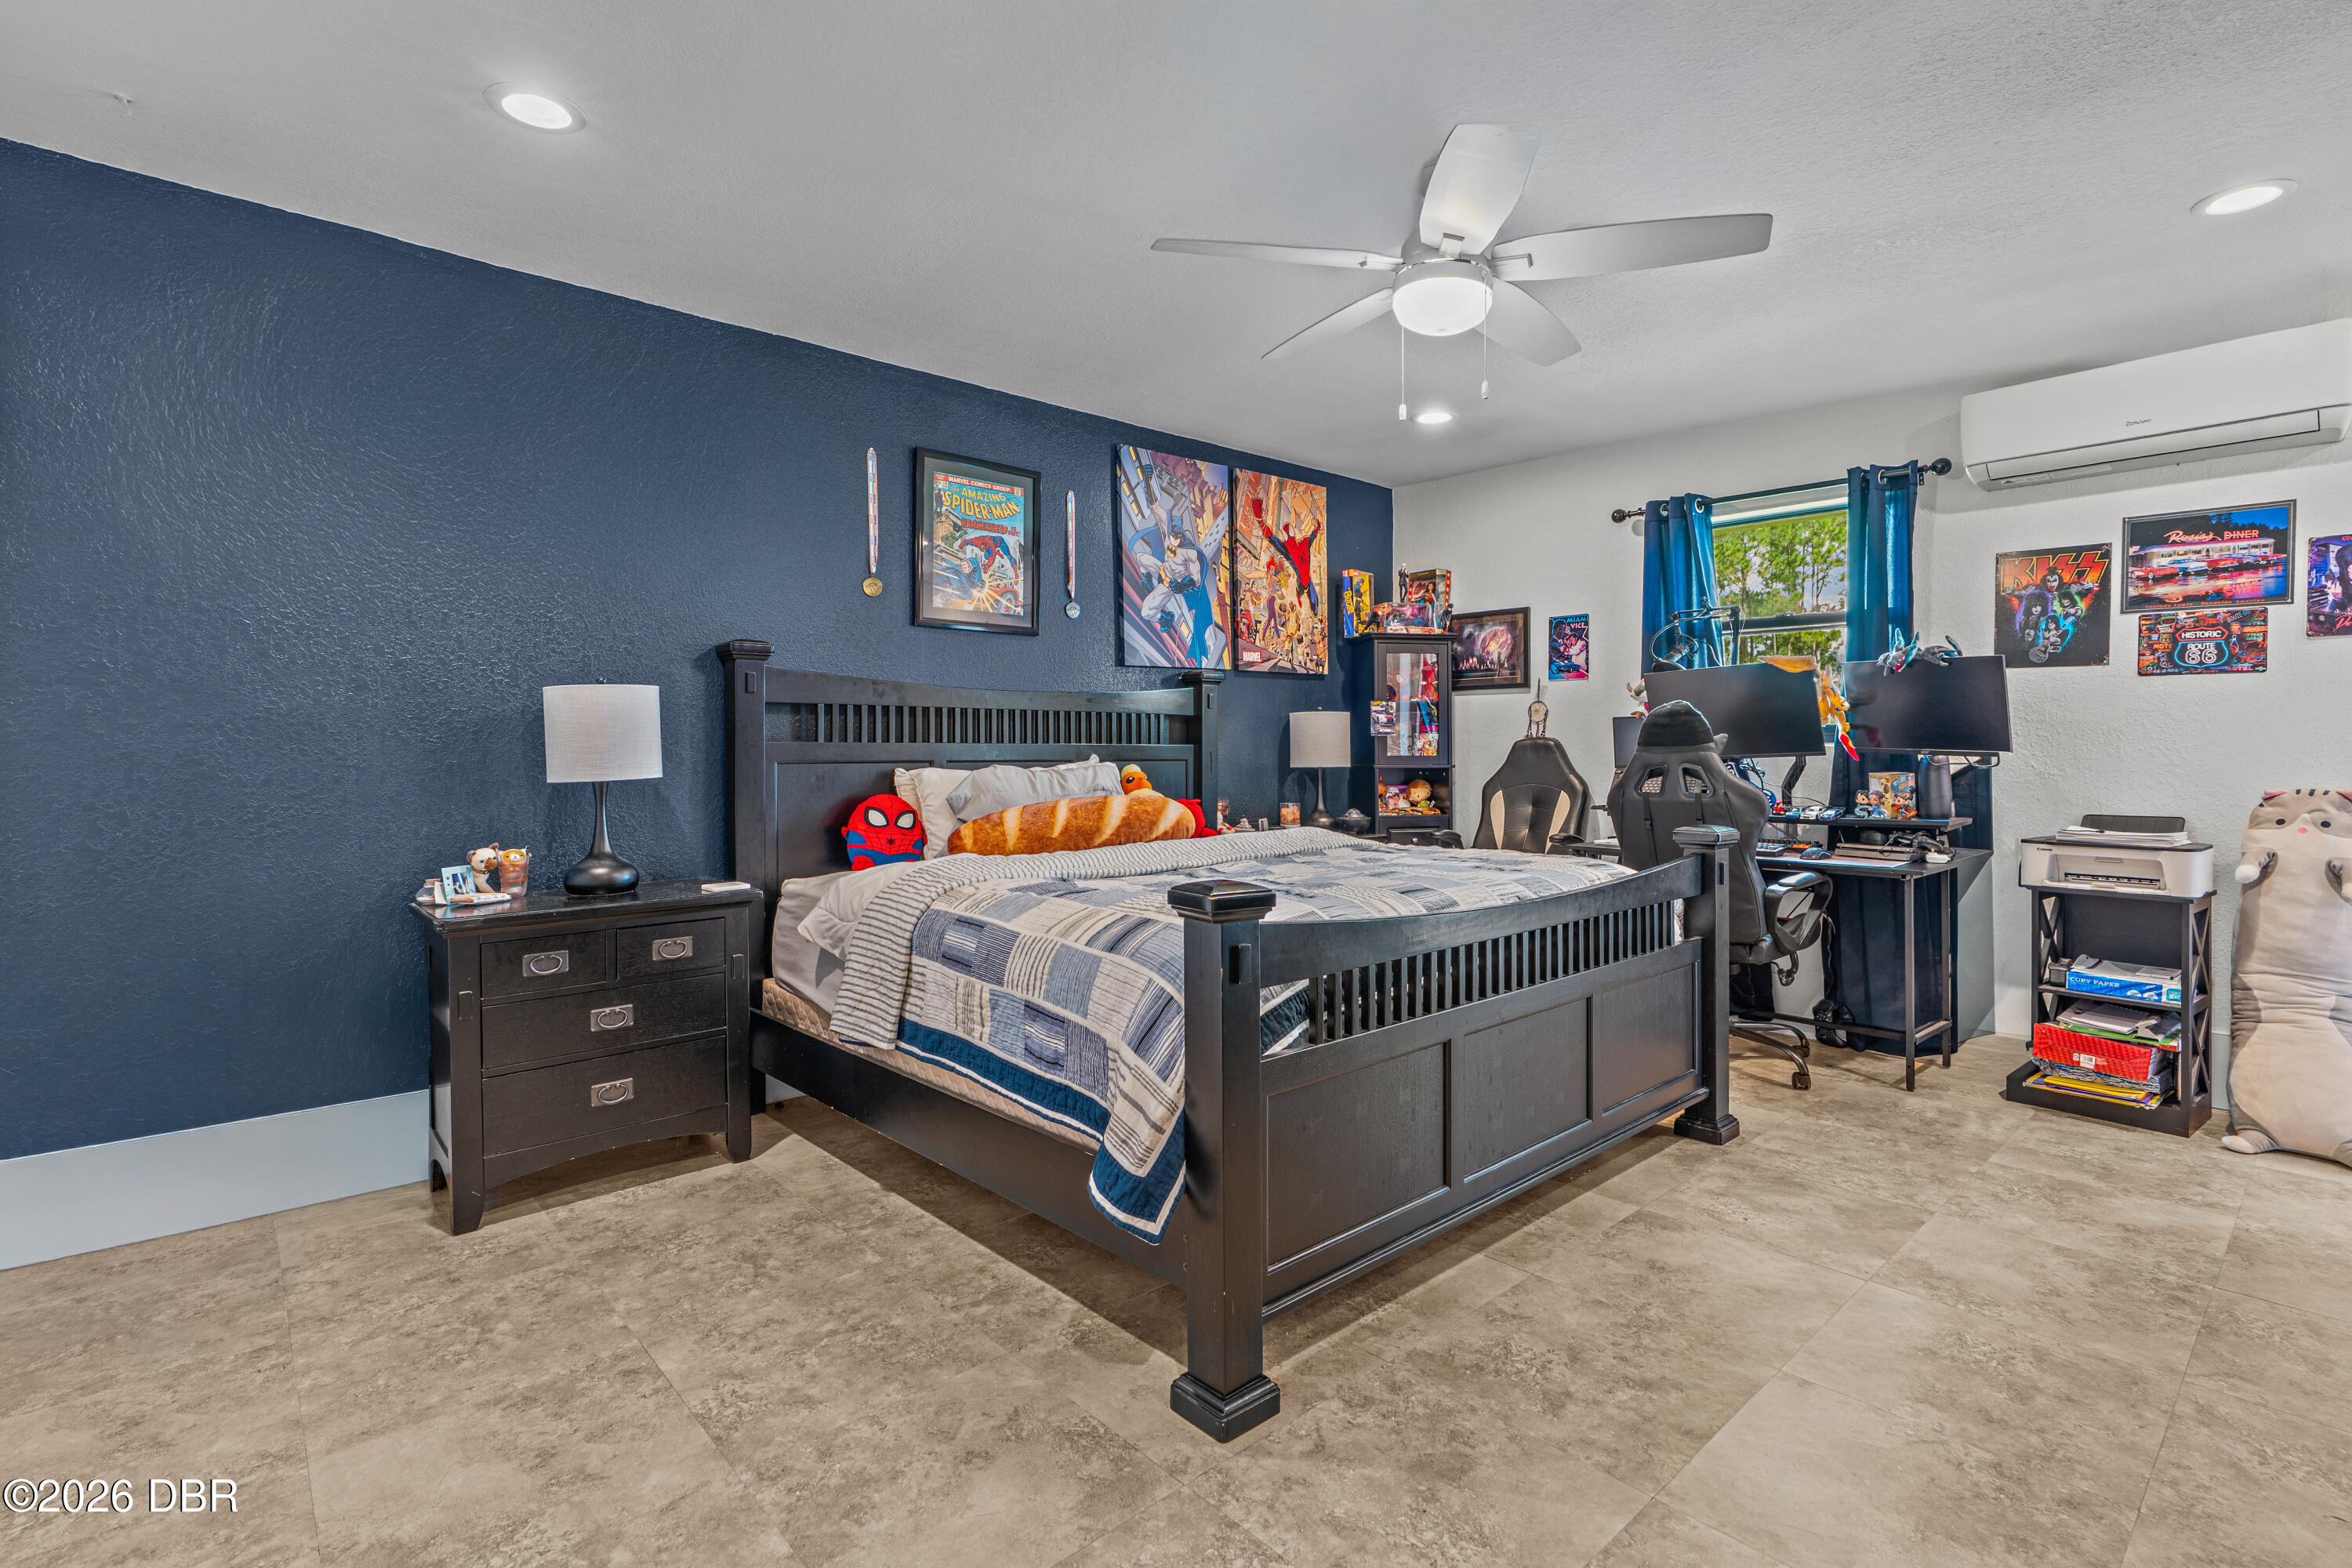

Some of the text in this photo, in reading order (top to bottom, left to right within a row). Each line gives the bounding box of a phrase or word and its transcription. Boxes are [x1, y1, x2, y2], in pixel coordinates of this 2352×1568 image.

[948, 476, 970, 485] MARVEL
[971, 480, 992, 489] COMICS
[961, 487, 1006, 503] AMAZING
[942, 491, 1021, 521] SPIDER-MAN
[961, 517, 1008, 535] HAMMERHEAD
[2164, 529, 2259, 544] Rosie's DINER
[2001, 550, 2110, 594] KISS
[2227, 612, 2243, 623] ROUTE
[2181, 630, 2222, 639] HISTORIC
[1243, 651, 1261, 662] MARVEL
[2185, 649, 2218, 664] 66
[2093, 978, 2120, 988] PAPER
